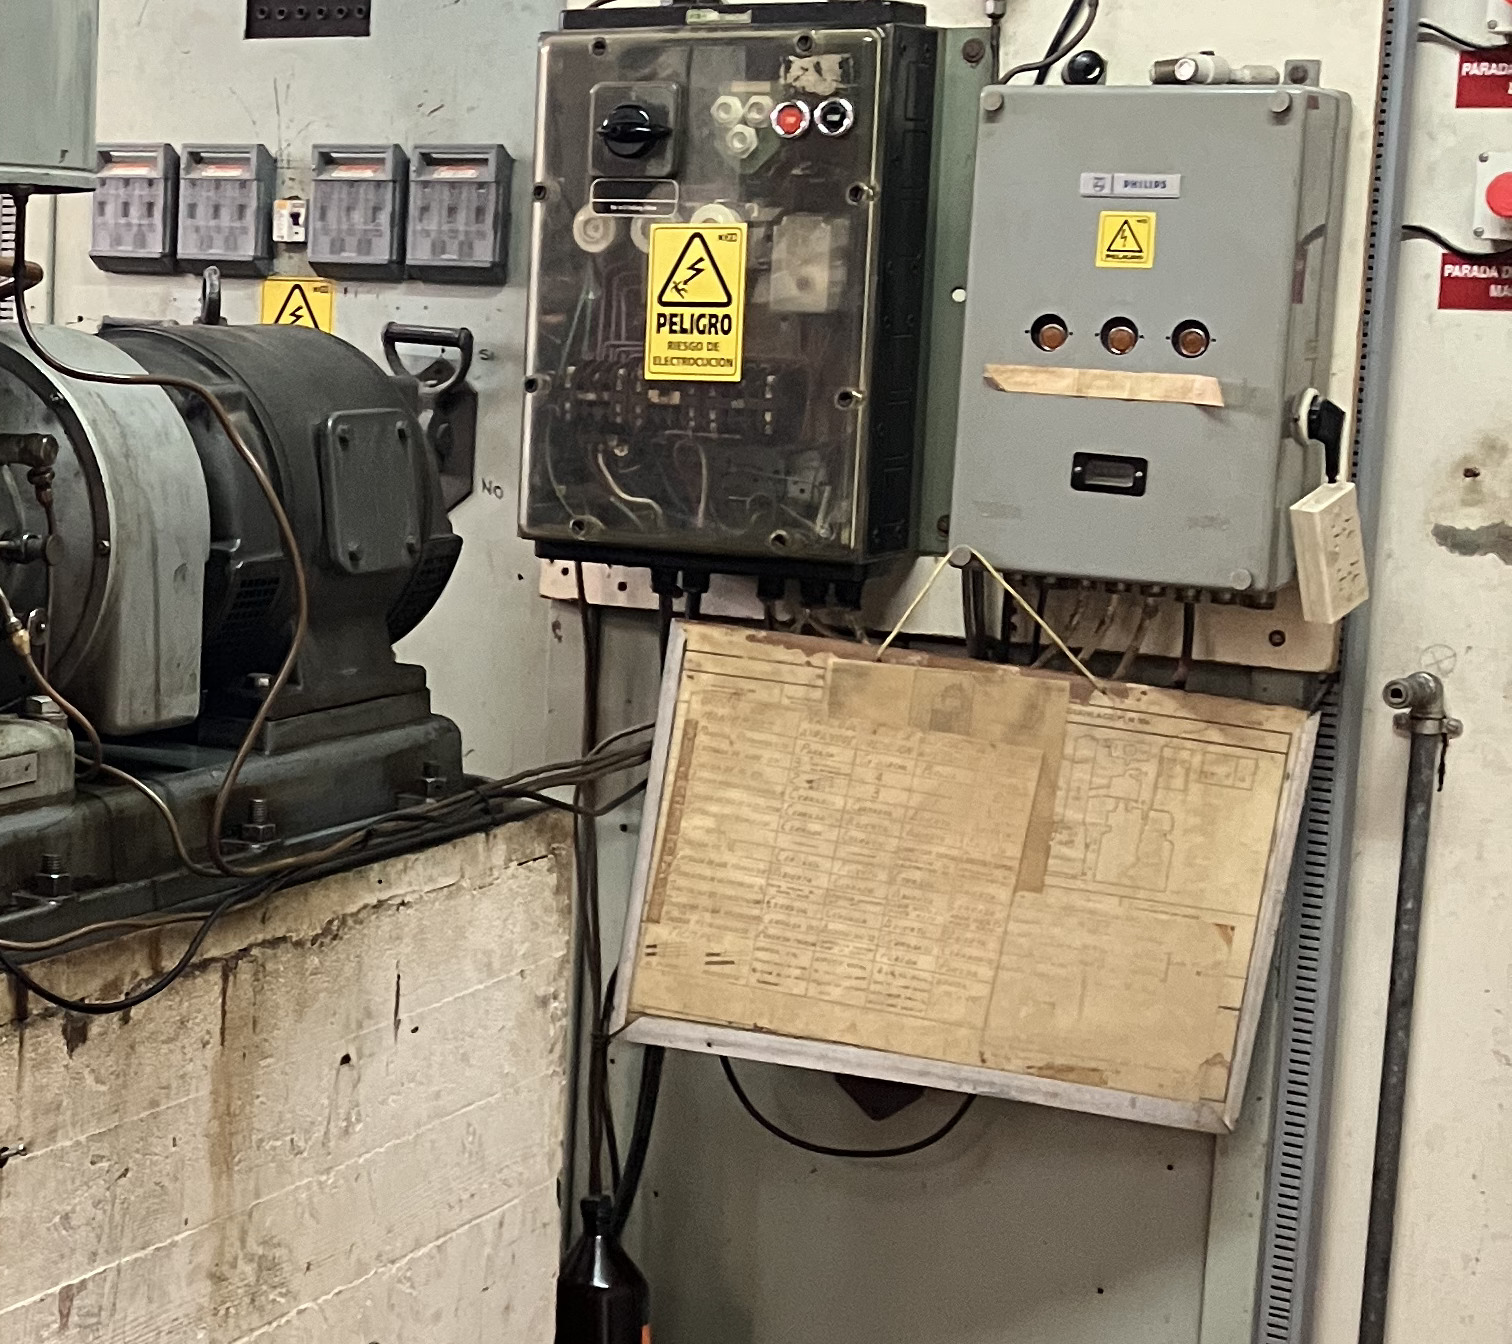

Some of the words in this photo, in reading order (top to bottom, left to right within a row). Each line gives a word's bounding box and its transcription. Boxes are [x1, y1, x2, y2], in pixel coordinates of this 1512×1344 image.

[1123, 179, 1167, 190] PHILIPS
[1443, 264, 1499, 279] PARADA
[656, 312, 733, 336] PELIGRO
[667, 340, 704, 352] RIESGO
[706, 341, 720, 352] DE
[481, 477, 504, 500] NO
